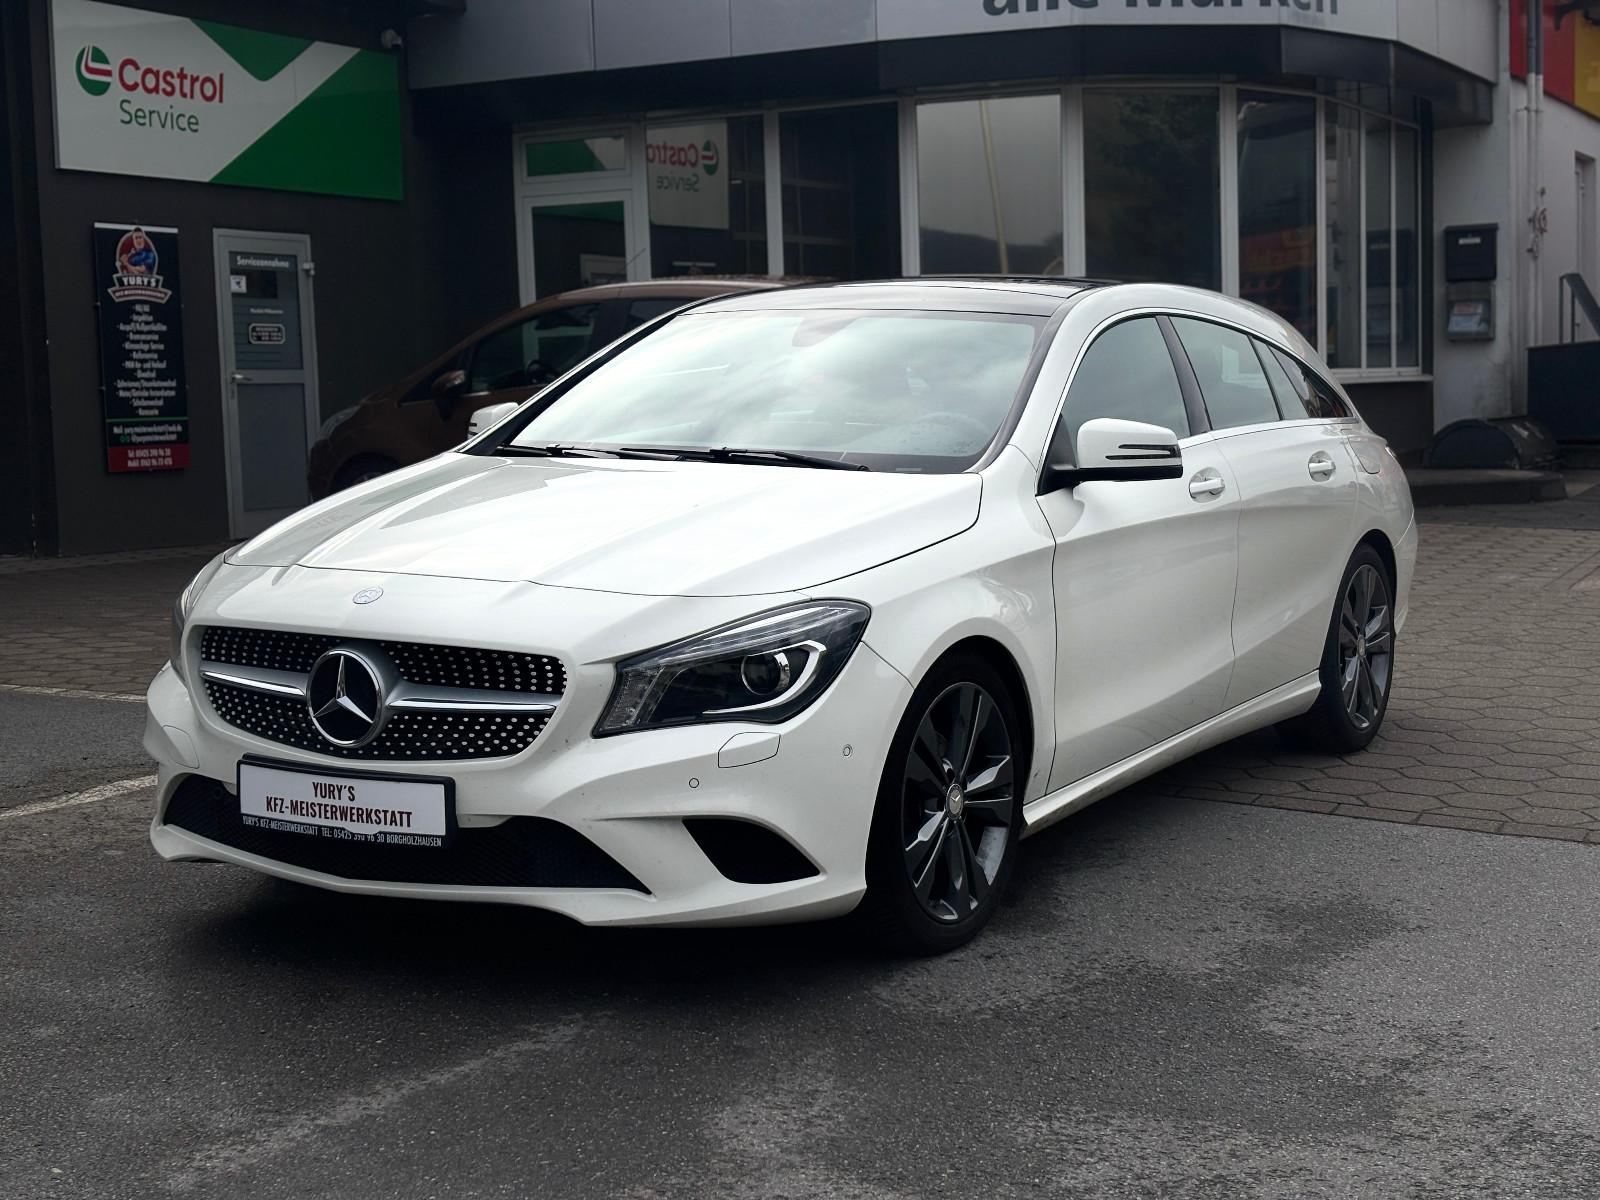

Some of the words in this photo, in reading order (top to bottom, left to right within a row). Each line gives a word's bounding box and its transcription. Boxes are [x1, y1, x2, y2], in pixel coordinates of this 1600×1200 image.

[118, 58, 224, 103] Castrol
[119, 99, 200, 133] Service
[312, 781, 356, 802] YURY'S
[265, 795, 413, 828] KFZ-MEISTERWERKSTATT
[260, 818, 319, 836] KFZ-MEISTERWERKSTATT
[376, 833, 385, 843] 30
[386, 833, 442, 847] BORGHOLZHAUSEN
